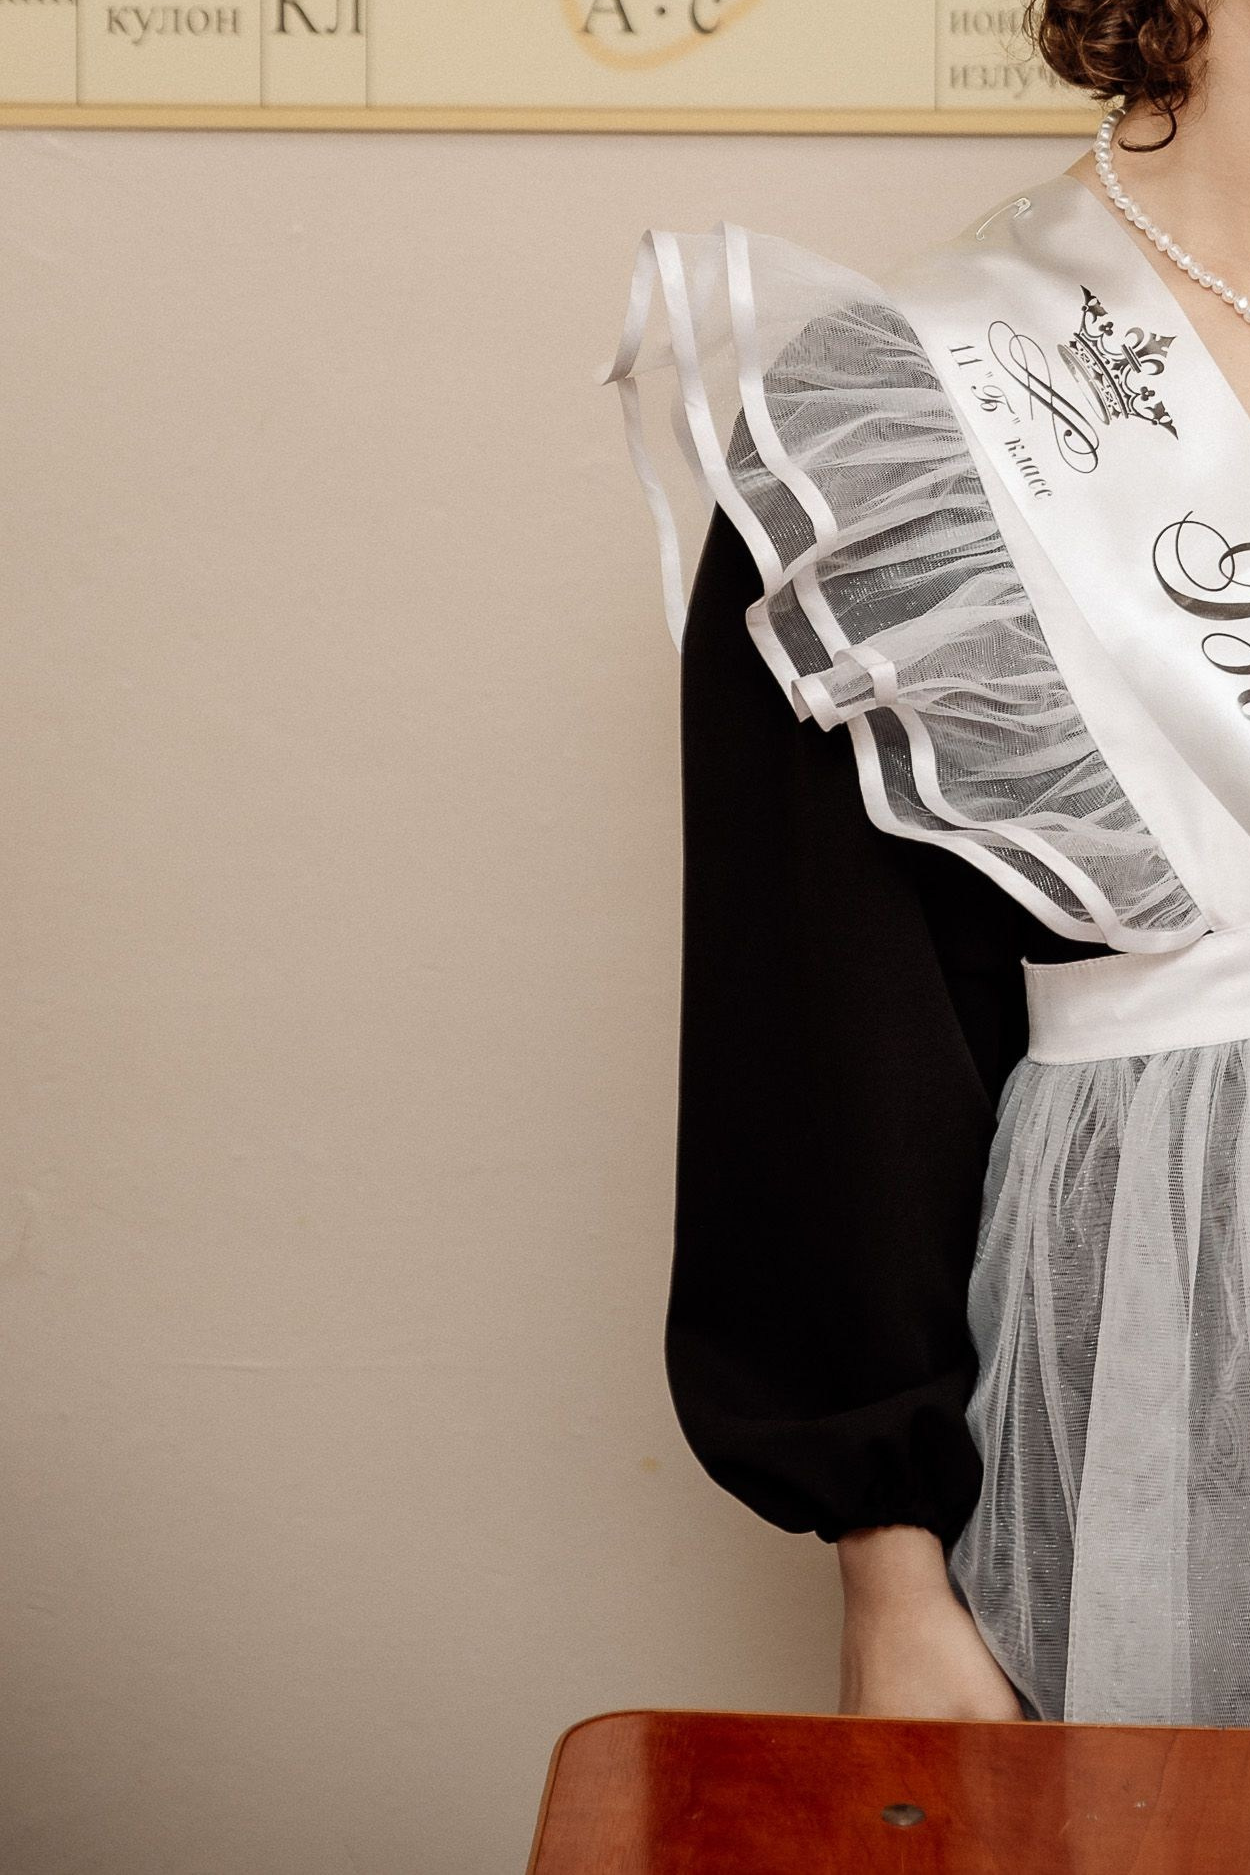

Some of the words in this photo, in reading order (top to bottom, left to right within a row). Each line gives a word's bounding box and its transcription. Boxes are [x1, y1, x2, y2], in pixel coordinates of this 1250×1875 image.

[106, 2, 241, 45] кулон
[948, 340, 984, 371] 11
[1004, 436, 1054, 501] класс
